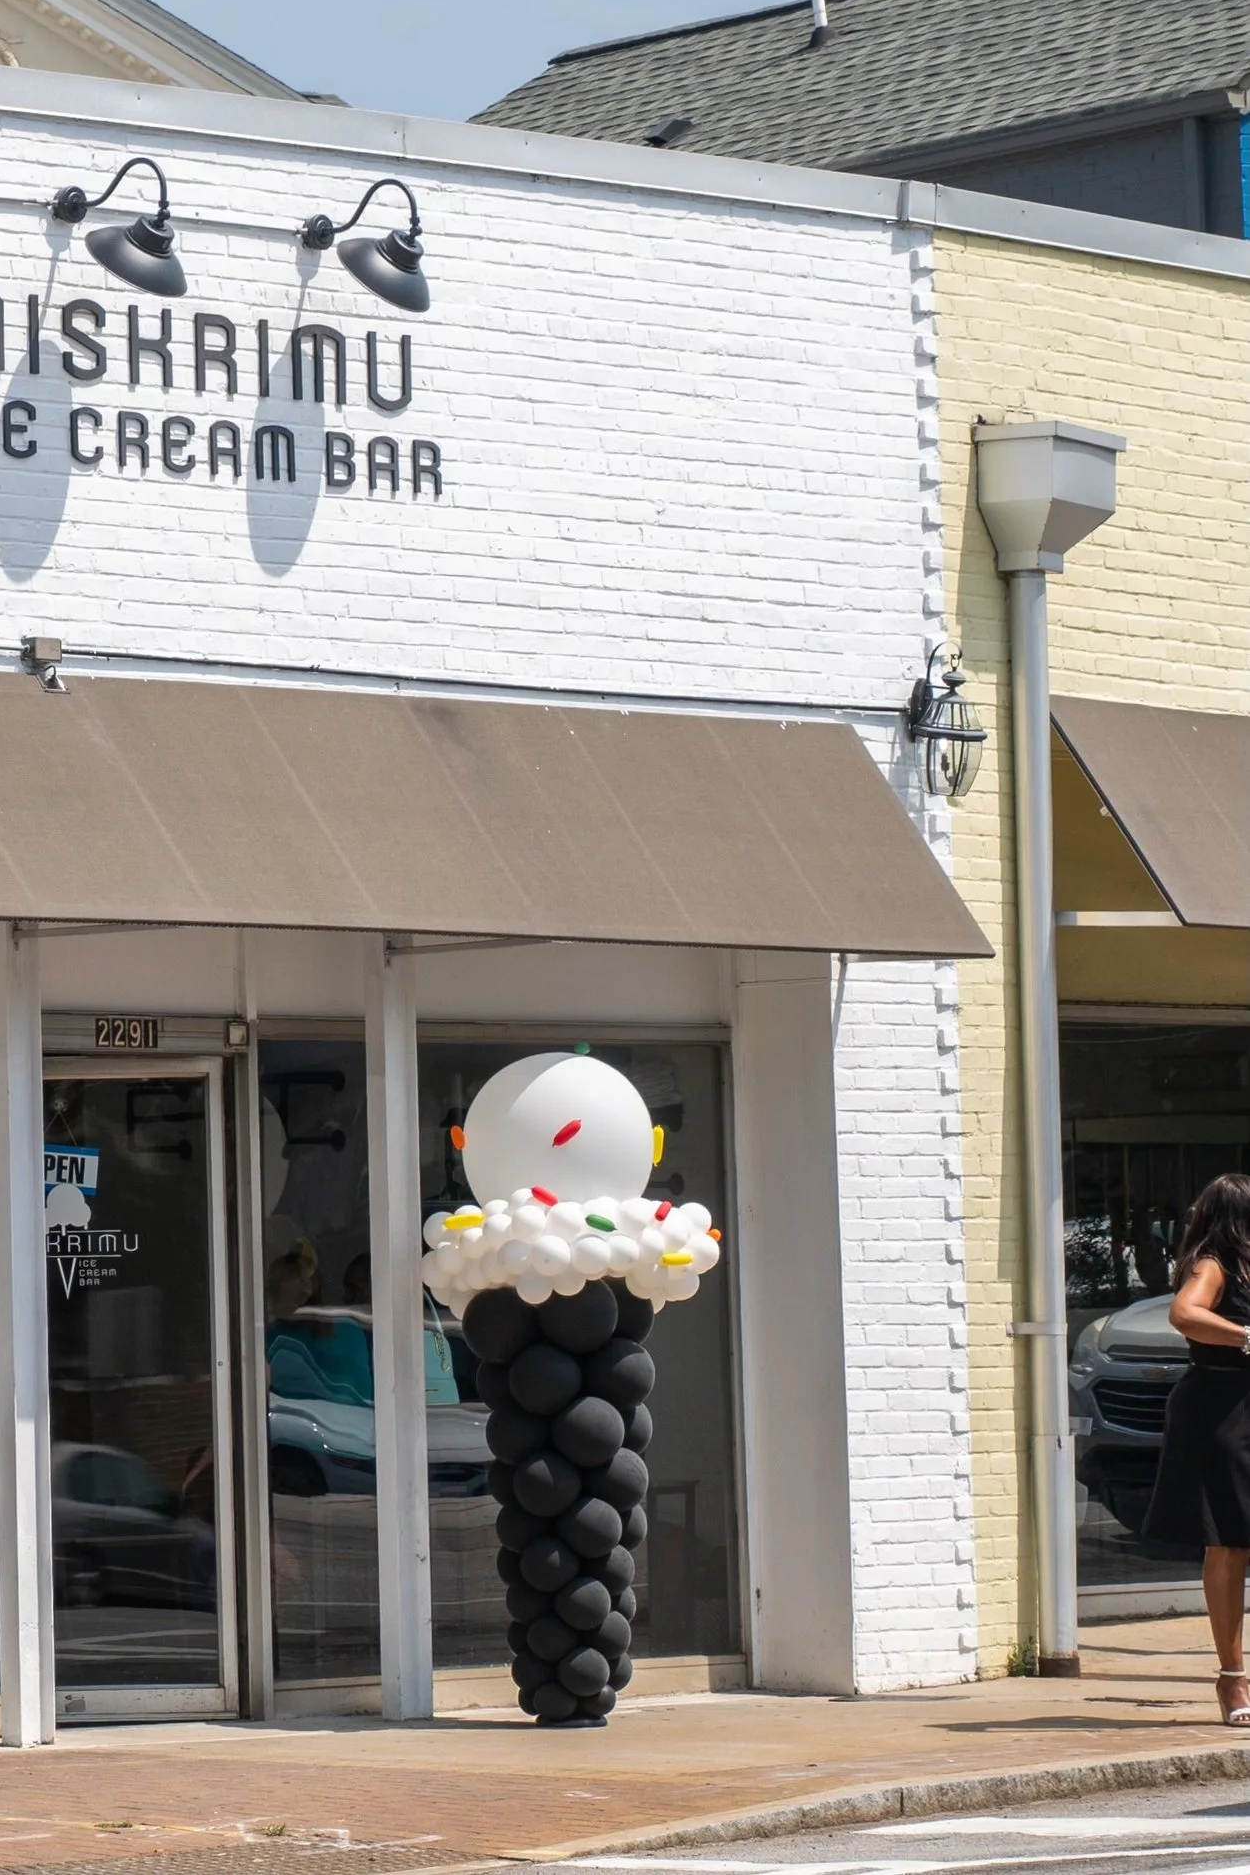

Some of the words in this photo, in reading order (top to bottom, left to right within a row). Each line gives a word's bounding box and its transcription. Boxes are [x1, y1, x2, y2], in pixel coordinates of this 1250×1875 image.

[69, 405, 297, 484] CREAM
[325, 430, 443, 496] BAR
[97, 1019, 153, 1047] 2291
[44, 1154, 86, 1184] PEN
[46, 1233, 139, 1253] KRIMU
[78, 1259, 98, 1268] ICE
[79, 1268, 117, 1277] CREAM
[78, 1278, 101, 1287] BAR
